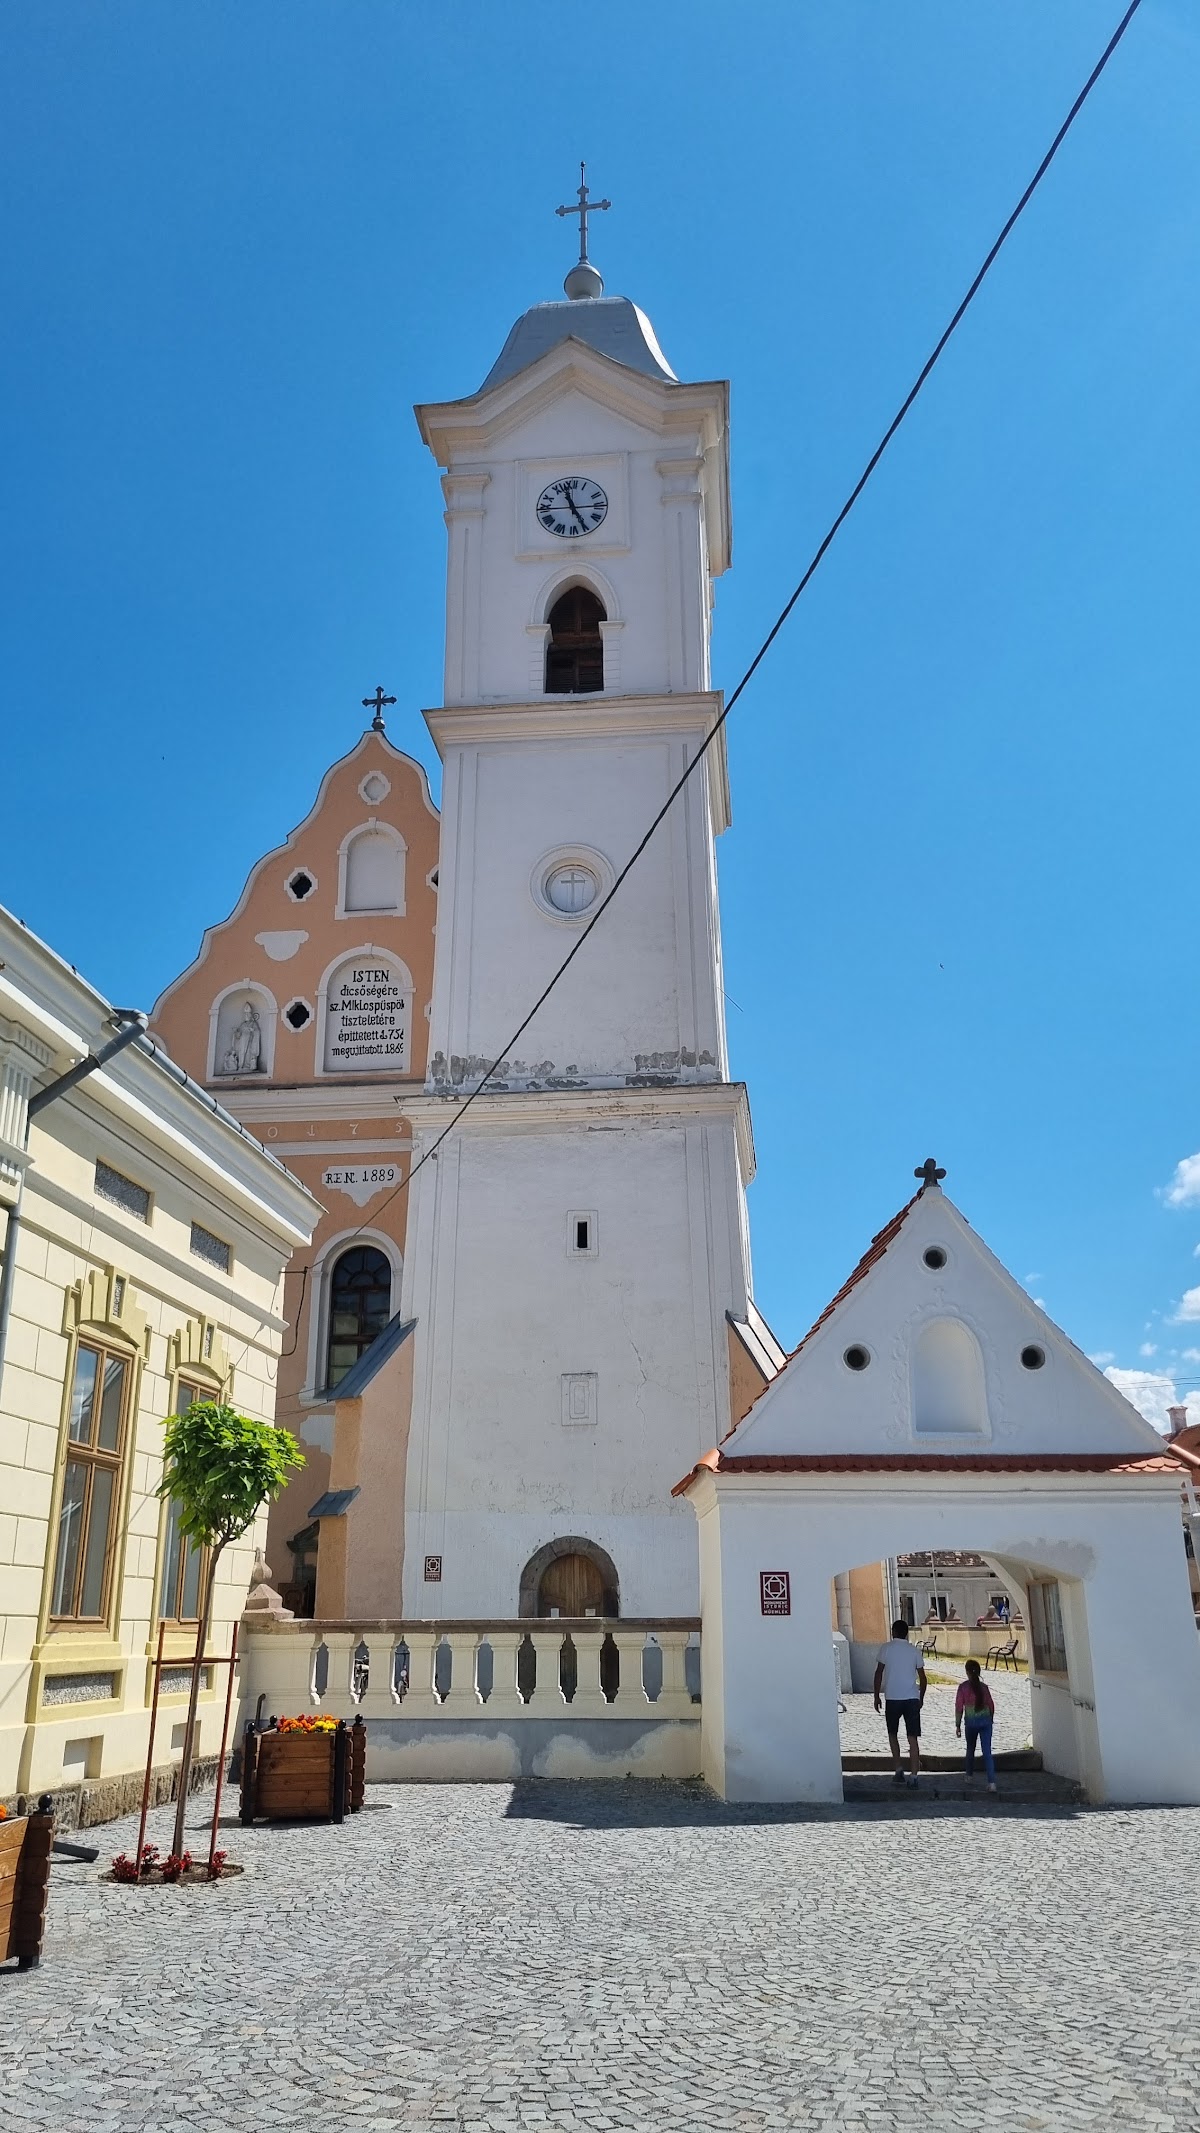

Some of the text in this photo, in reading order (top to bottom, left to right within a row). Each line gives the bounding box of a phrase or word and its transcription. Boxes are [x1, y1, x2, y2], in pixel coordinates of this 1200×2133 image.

[352, 969, 390, 983] ISTEN
[341, 1012, 395, 1027] tiszteletére
[325, 1168, 395, 1184] REN. 1889
